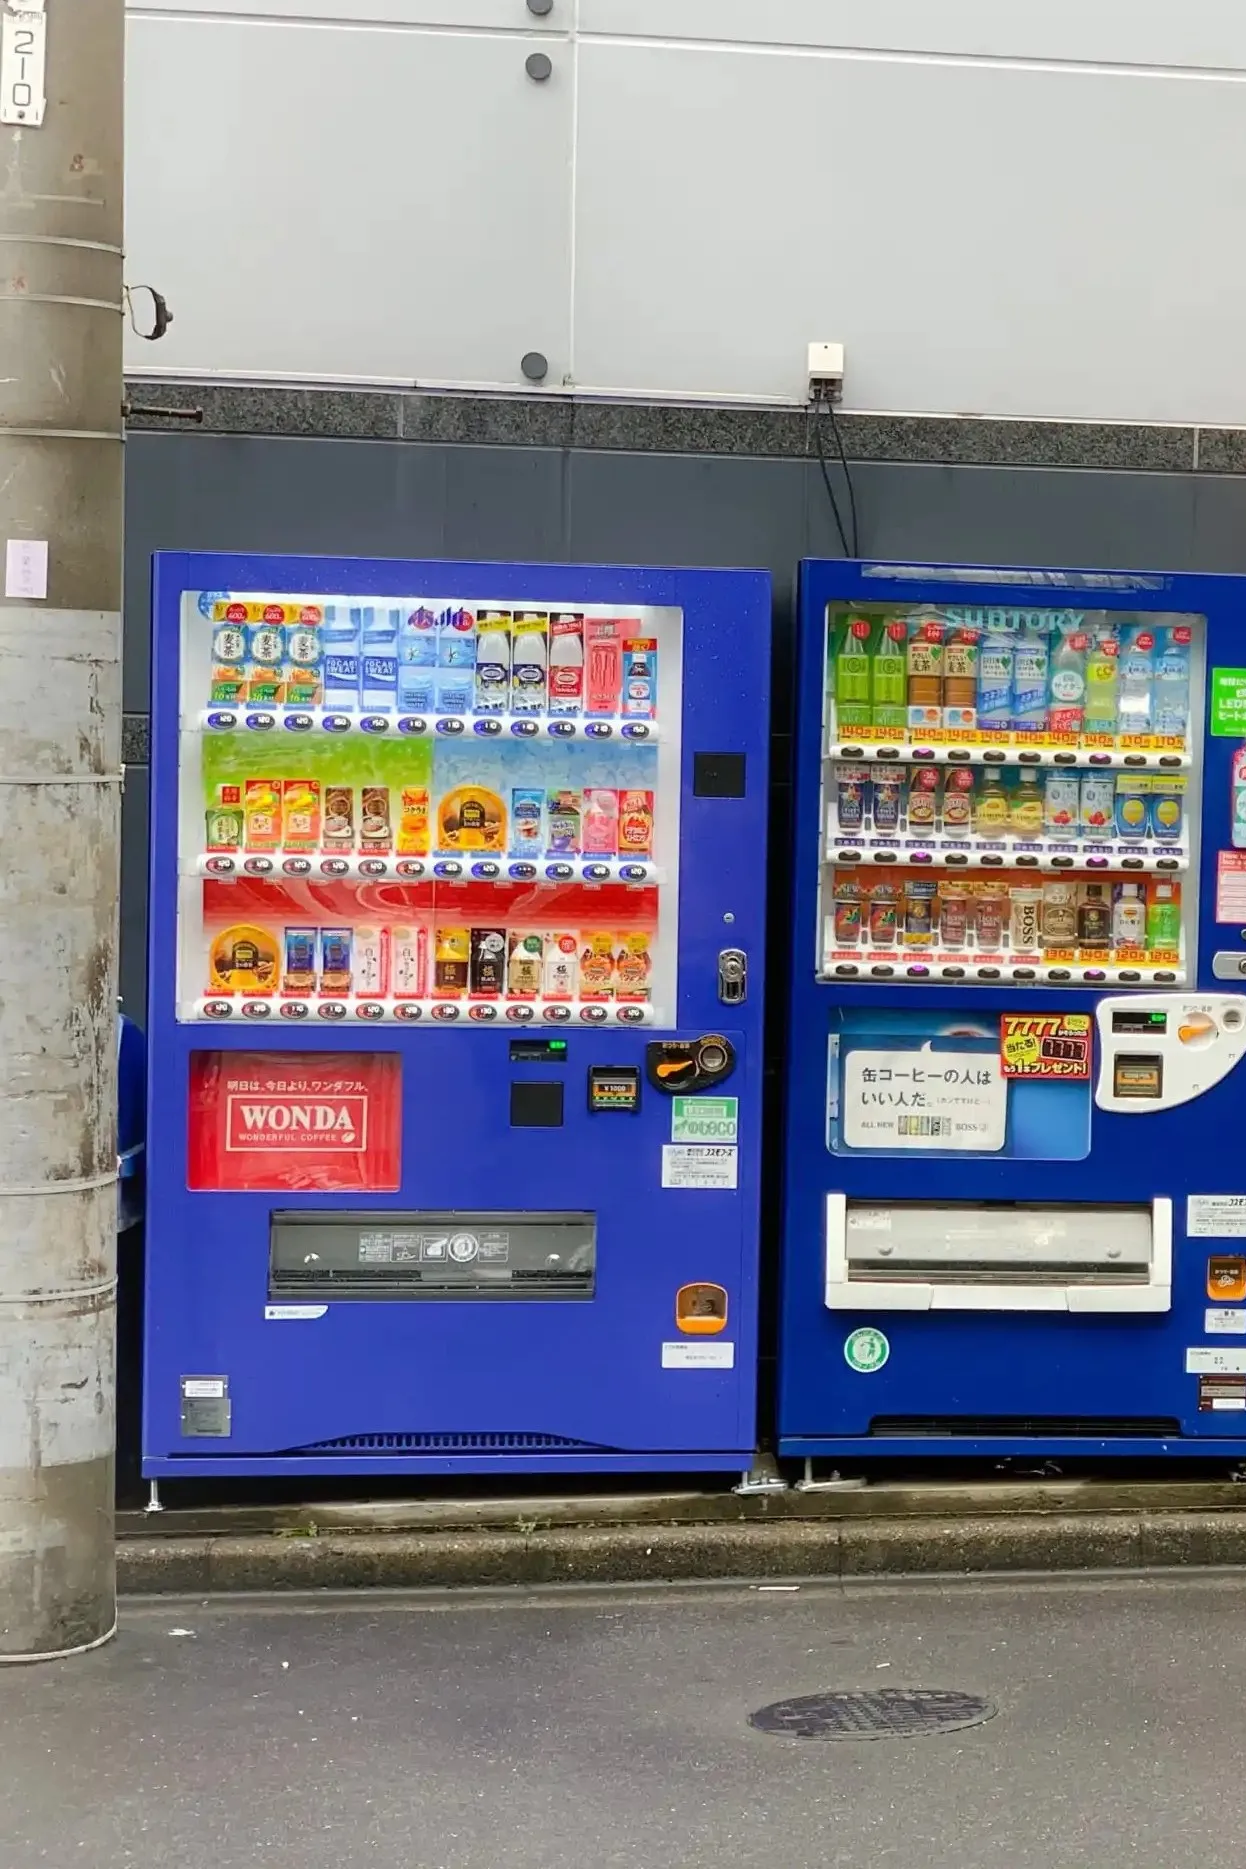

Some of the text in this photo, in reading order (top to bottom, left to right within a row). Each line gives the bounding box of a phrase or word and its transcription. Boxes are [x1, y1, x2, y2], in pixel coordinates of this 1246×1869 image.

[1023, 905, 1035, 945] BOSS
[1005, 1017, 1061, 1035] 7777
[1006, 1038, 1036, 1053] 当たる!
[1045, 1039, 1085, 1058] 7777
[862, 1067, 992, 1085] 缶コーヒーの人は
[240, 1105, 355, 1130] WONDA
[955, 1123, 977, 1132] BOSS
[239, 1133, 336, 1142] WONDERFUL COFFEE
